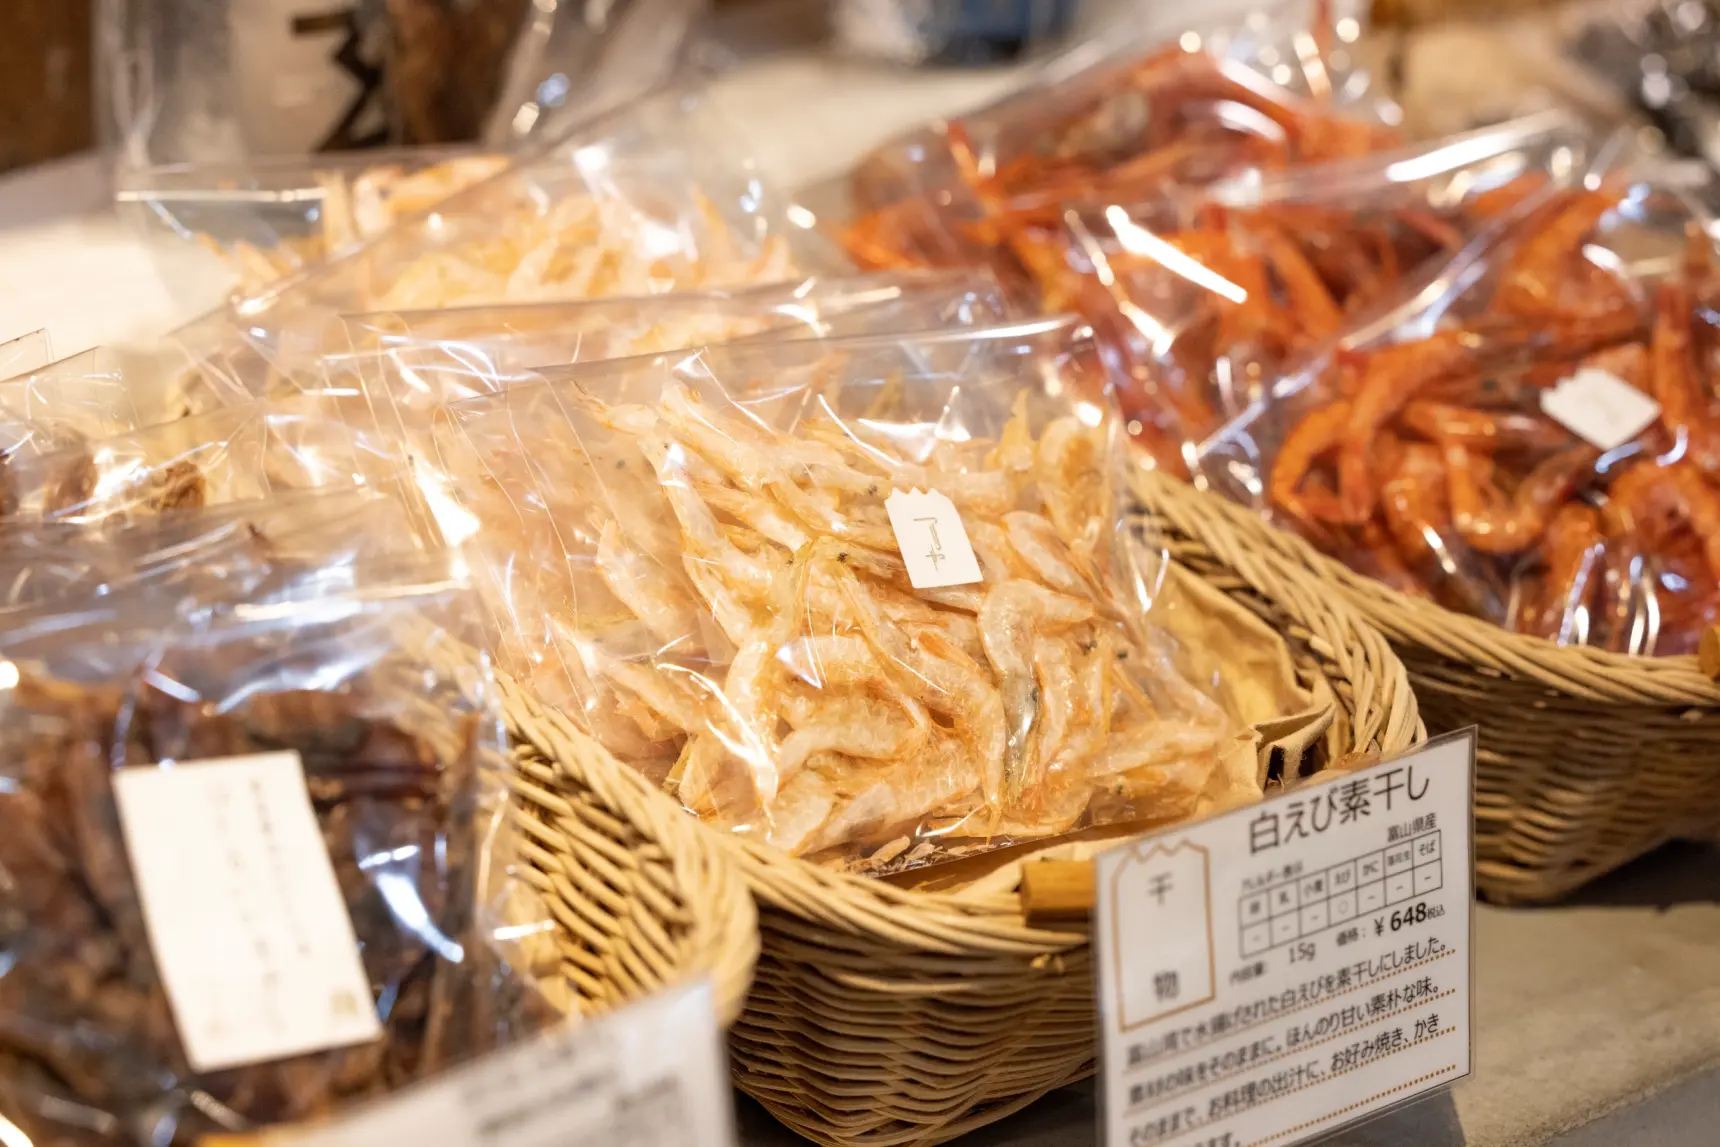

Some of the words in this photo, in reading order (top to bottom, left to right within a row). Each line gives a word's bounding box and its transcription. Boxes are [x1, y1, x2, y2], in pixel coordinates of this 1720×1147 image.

[1248, 764, 1431, 855] 白えび素干し
[1386, 812, 1438, 843] 富山県産
[1418, 840, 1438, 857] そば
[1289, 941, 1318, 965] 15g
